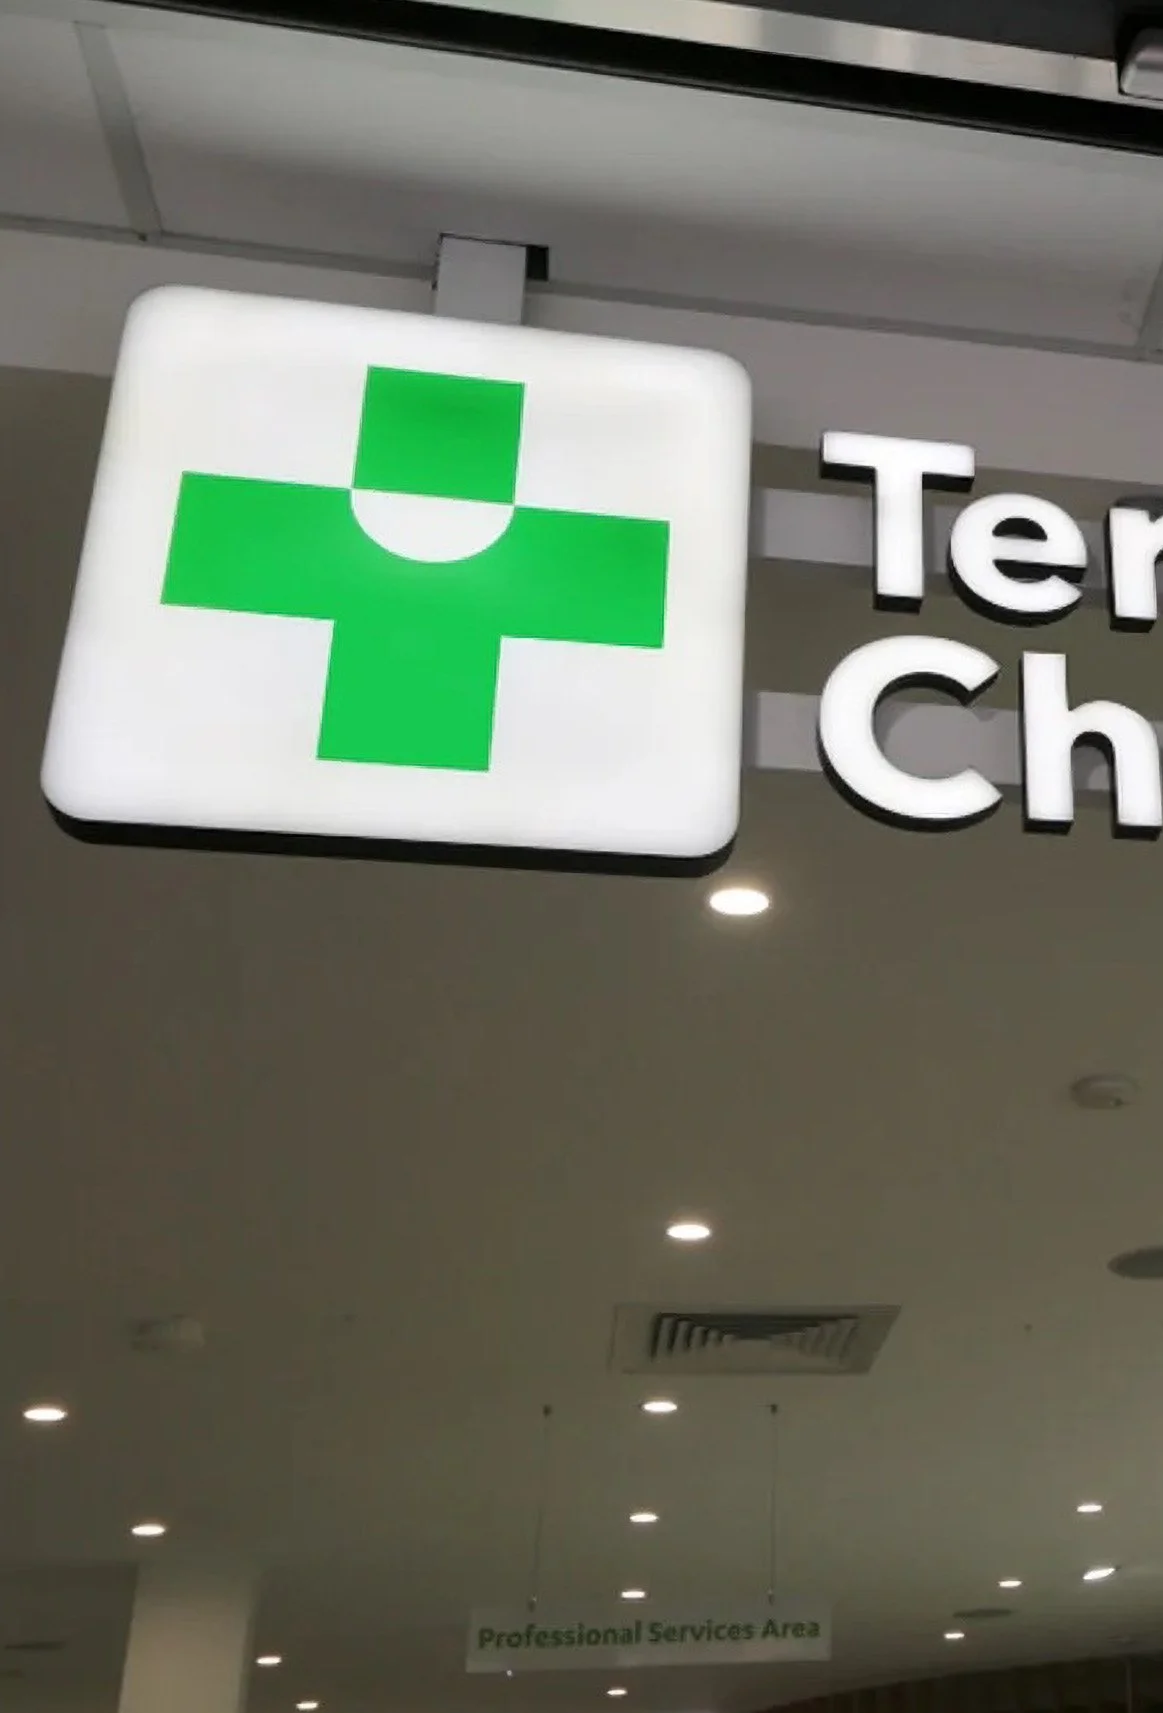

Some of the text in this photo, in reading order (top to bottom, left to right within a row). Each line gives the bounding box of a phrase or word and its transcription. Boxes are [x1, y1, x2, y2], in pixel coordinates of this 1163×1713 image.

[477, 1617, 821, 1650] Professional Services Area
